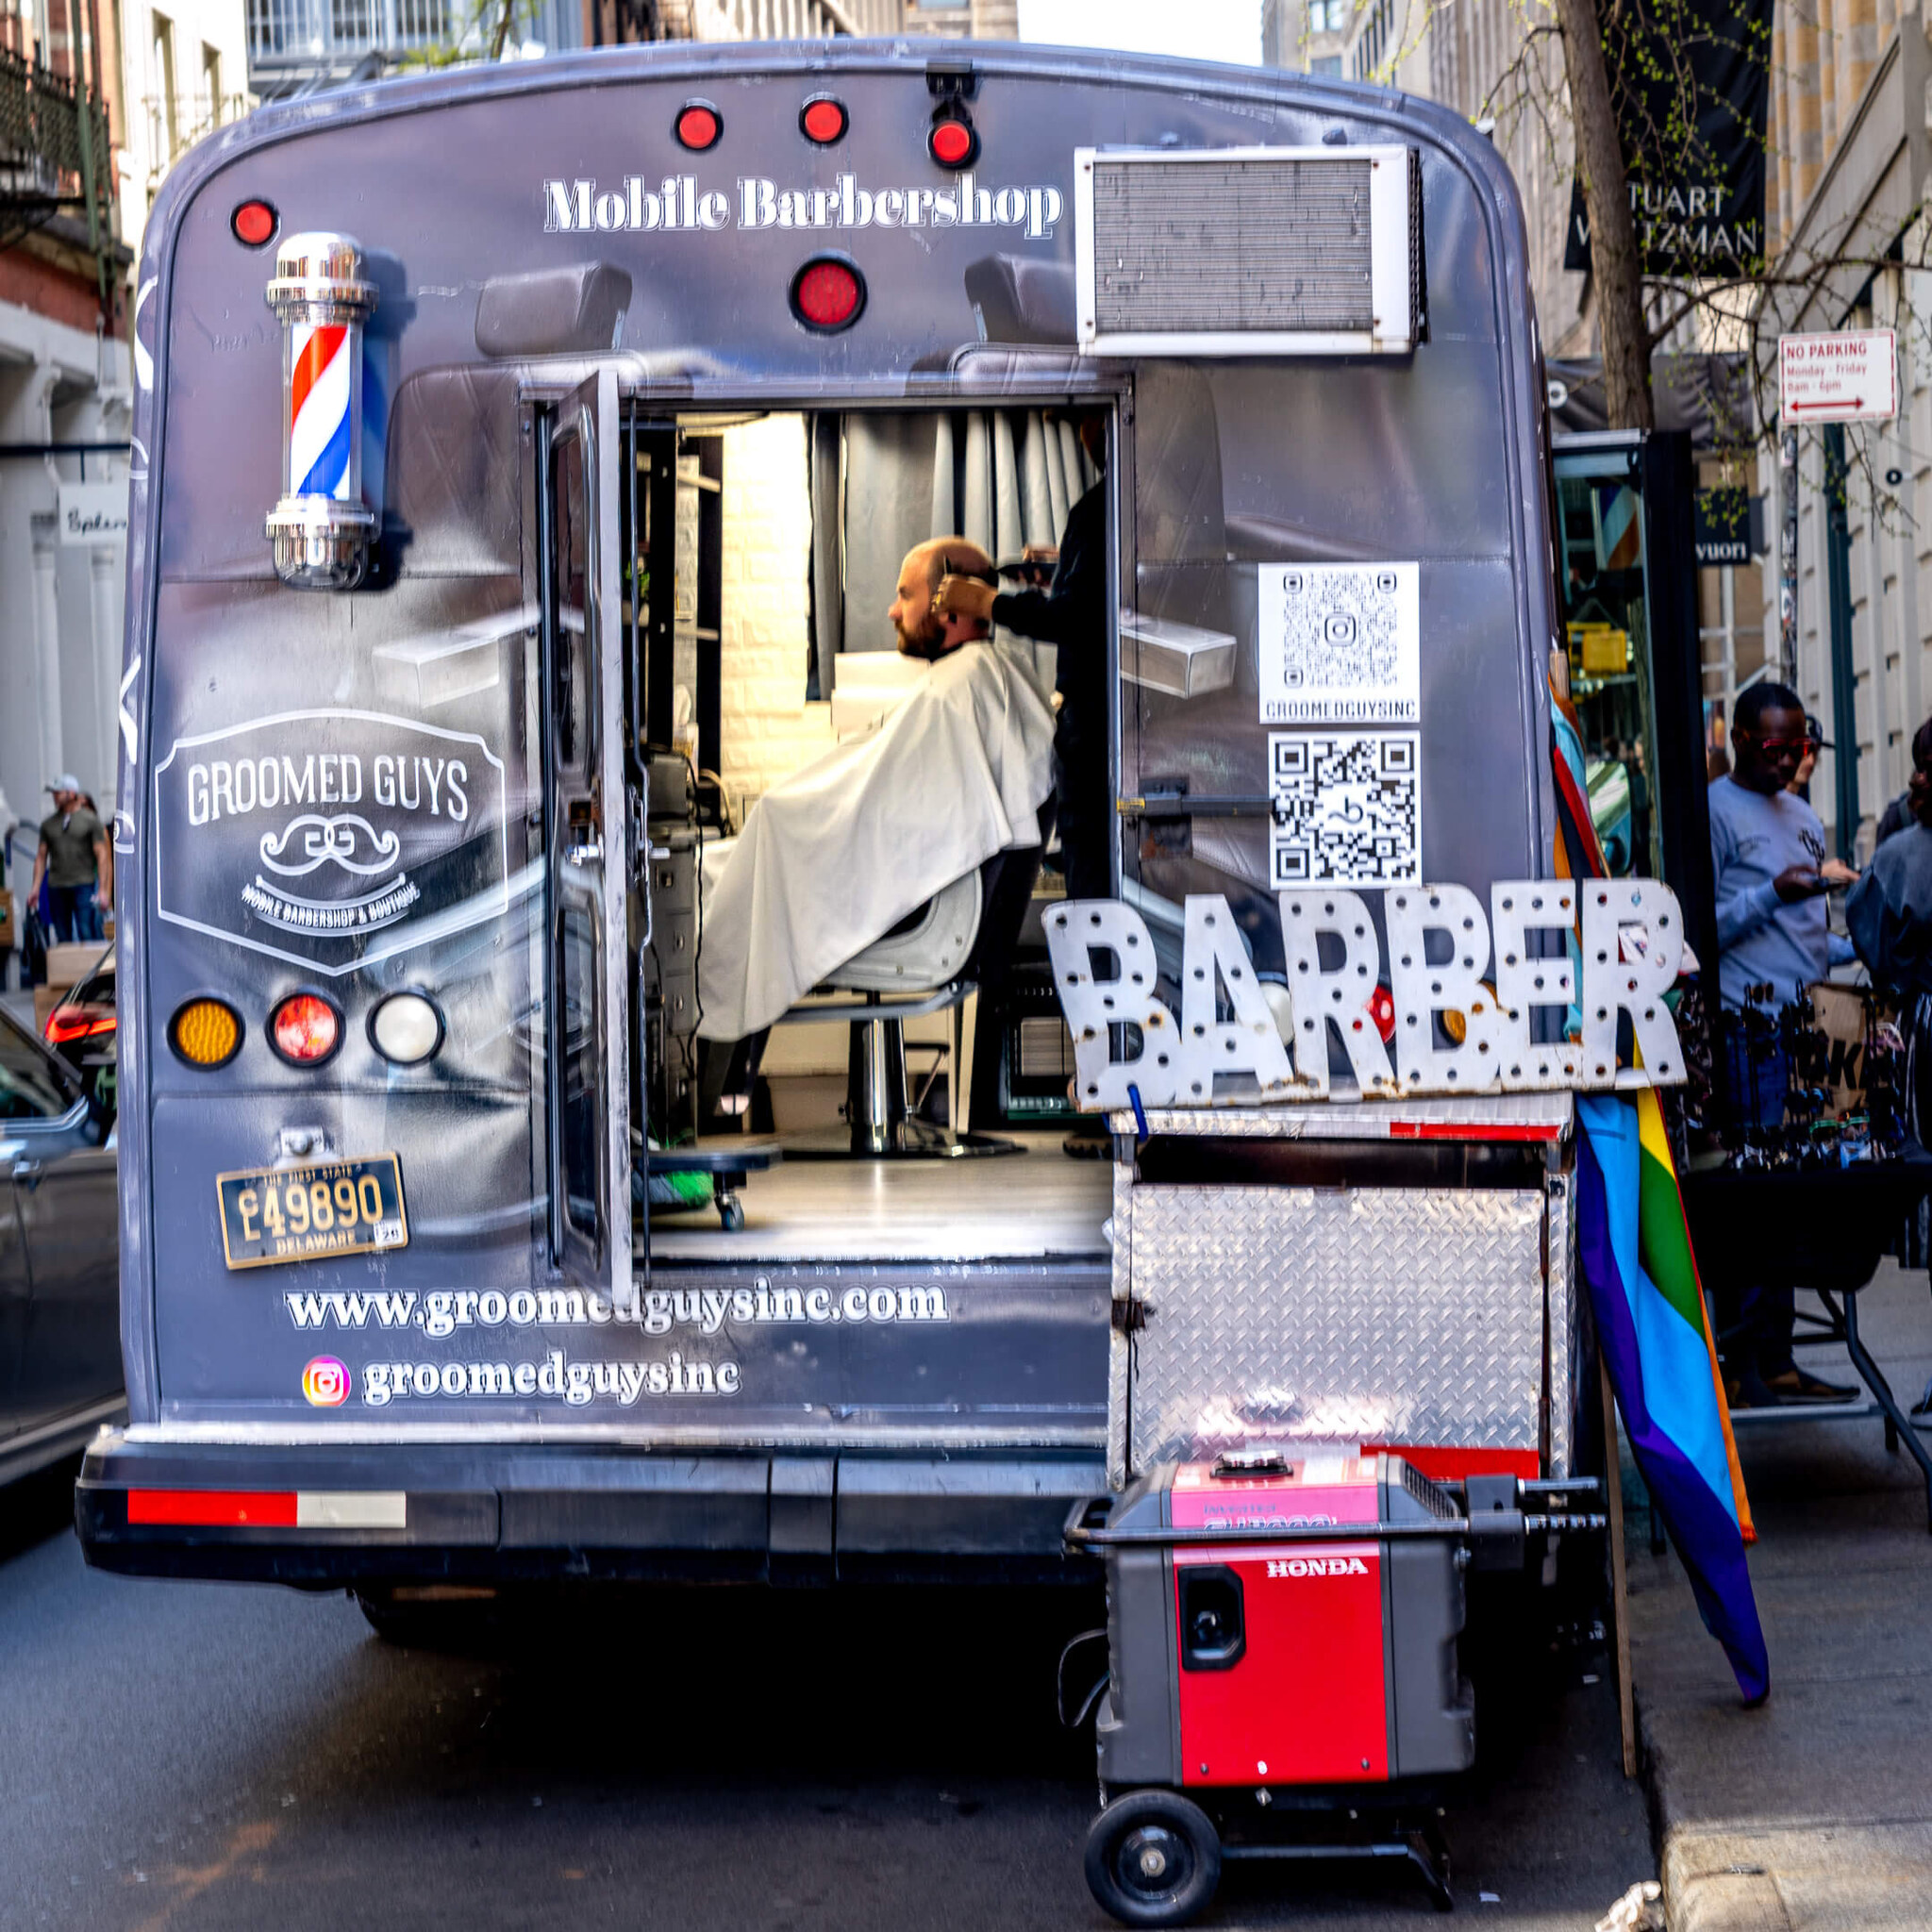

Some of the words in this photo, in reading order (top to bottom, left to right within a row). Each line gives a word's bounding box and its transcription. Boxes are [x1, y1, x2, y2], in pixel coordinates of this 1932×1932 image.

[543, 175, 730, 233] Mobile
[737, 172, 1063, 240] Barbershop
[1627, 180, 1726, 217] TUART
[1787, 344, 1805, 358] NO
[1809, 341, 1867, 358] PARKING
[1787, 365, 1825, 377] Monday
[1836, 361, 1867, 375] Friday
[1266, 698, 1416, 721] GROOMEDGUYSINC
[188, 755, 363, 826] GROOMED
[374, 755, 469, 823] GUYS
[242, 883, 282, 919] MOBILE
[283, 903, 354, 928] BARBERSHOP
[1041, 878, 1689, 1113] BARBER
[276, 1229, 357, 1256] DELAWARE
[361, 1345, 743, 1407] groomedguysinc
[1266, 1557, 1369, 1578] HONDA
